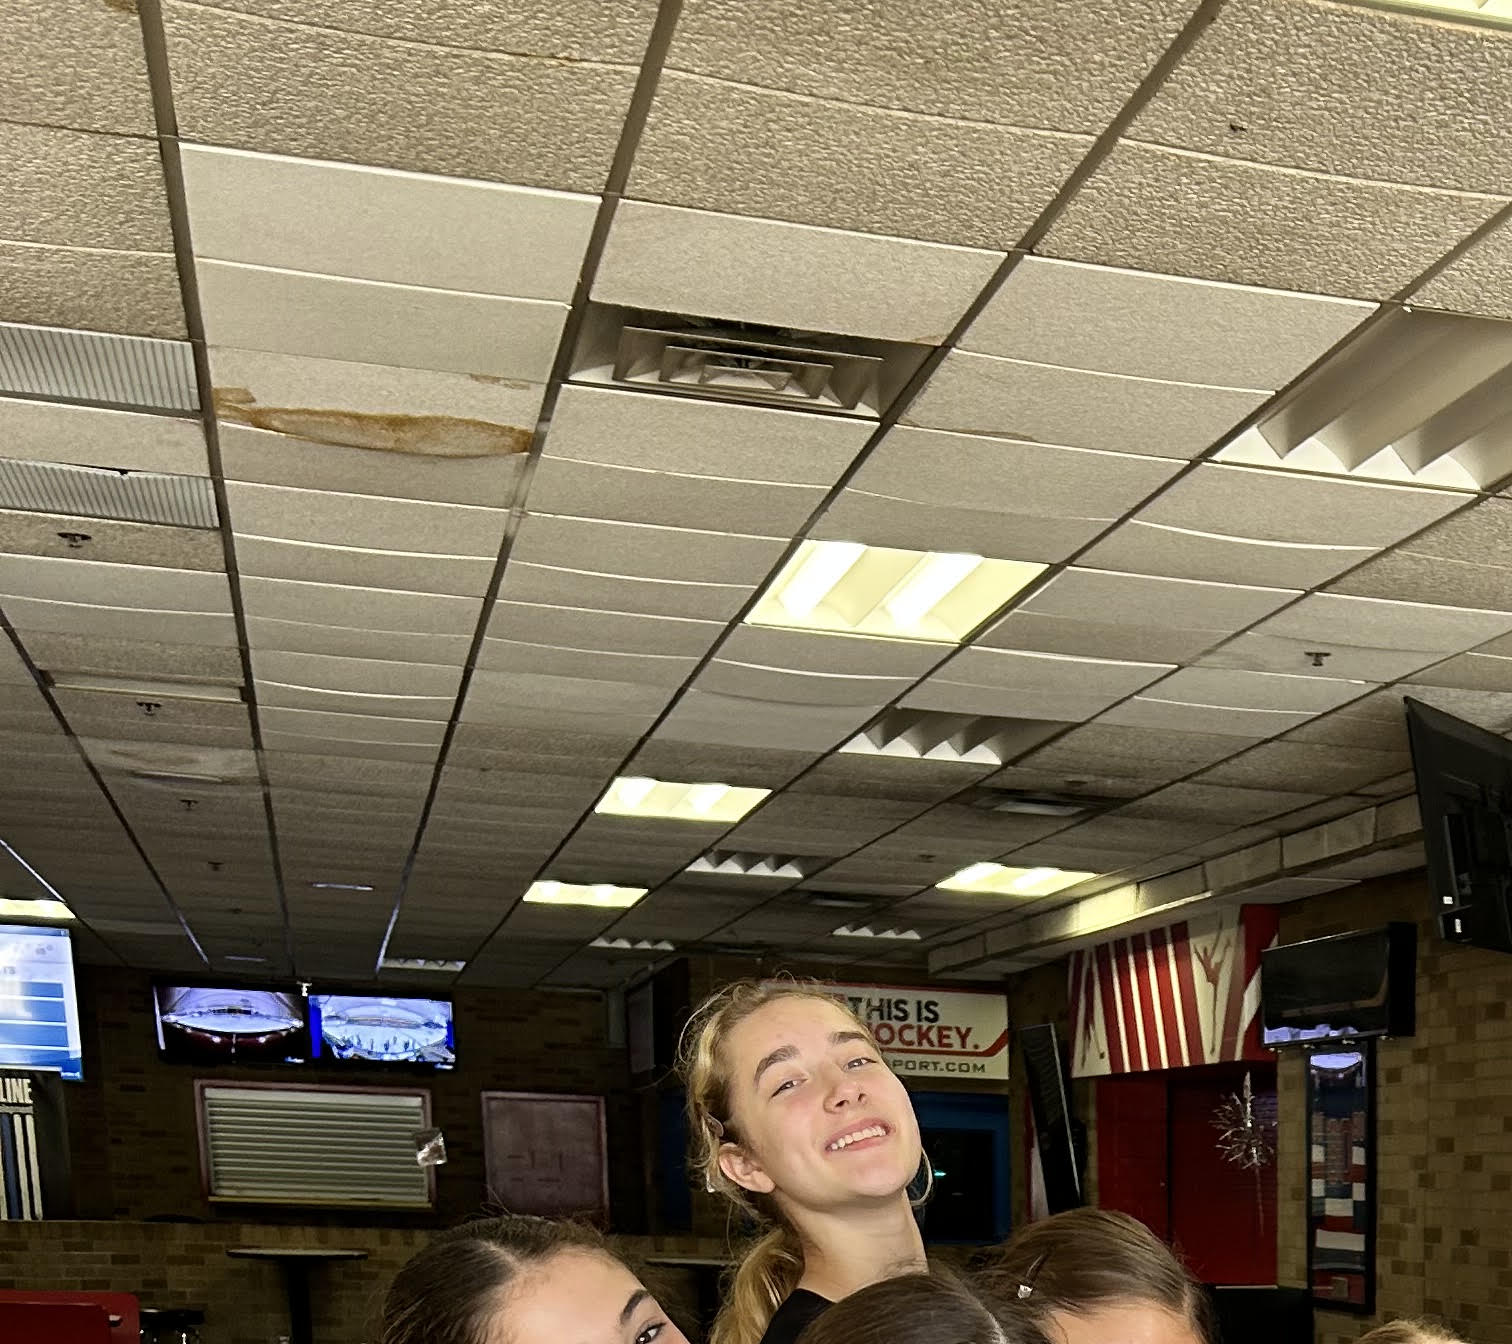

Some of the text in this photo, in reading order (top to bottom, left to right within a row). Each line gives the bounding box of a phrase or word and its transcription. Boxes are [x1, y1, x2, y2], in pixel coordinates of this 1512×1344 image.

[848, 997, 940, 1023] THIS IS
[868, 1022, 980, 1050] OCKEY.
